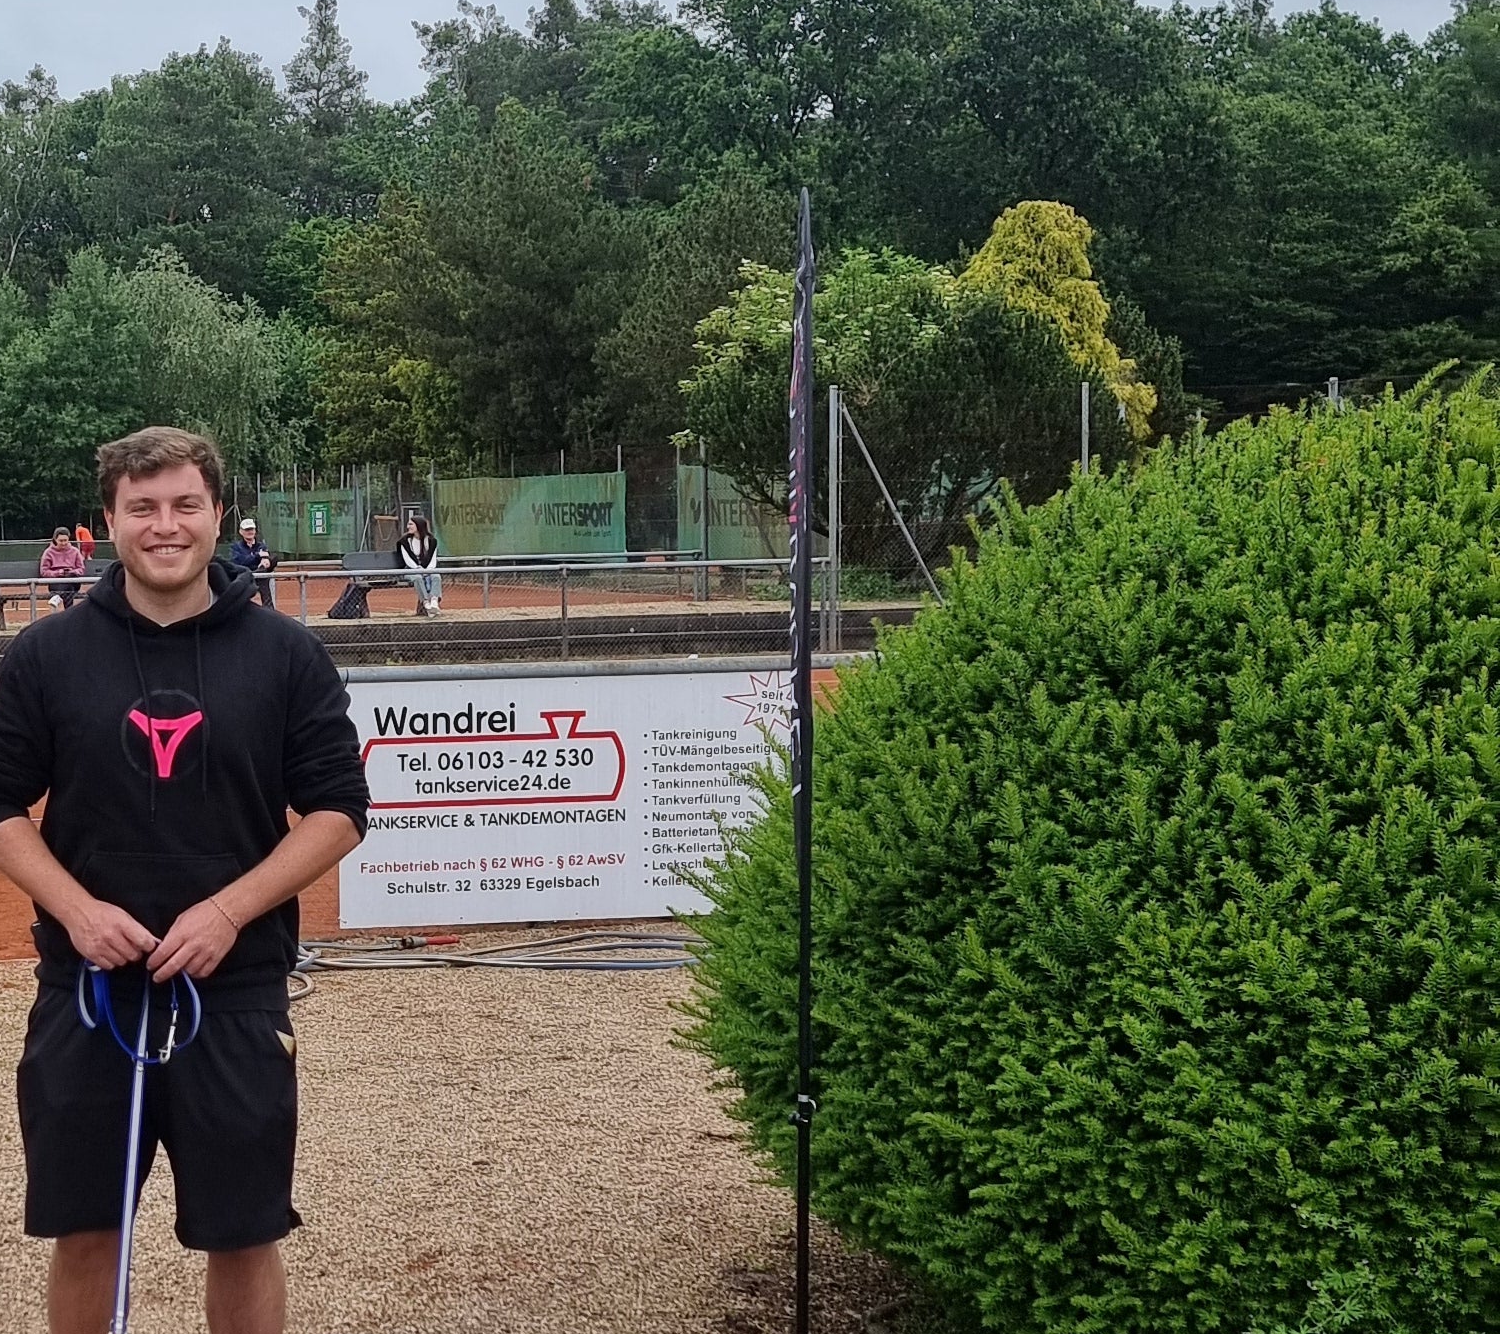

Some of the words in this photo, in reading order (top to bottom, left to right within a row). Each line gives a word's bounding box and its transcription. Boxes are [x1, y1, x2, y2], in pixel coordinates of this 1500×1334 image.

[761, 690, 783, 701] seit
[374, 702, 516, 736] Wandrei
[651, 729, 737, 742] Tankreinigung
[397, 752, 432, 772] Tel.
[437, 750, 504, 771] 06103
[521, 749, 547, 768] 42
[554, 748, 594, 767] 530
[415, 773, 571, 794] tankservice24.de
[651, 793, 741, 806] Tankverfüllung
[367, 814, 458, 830] ANKSERVICE
[463, 814, 475, 827] &
[480, 808, 626, 827] TANKDEMONTAGEN
[360, 860, 439, 873] Fachbetrieb
[443, 859, 476, 871] nach
[479, 858, 488, 872] §
[491, 857, 507, 869] 62
[510, 856, 545, 868] WHG
[556, 856, 564, 869] §
[568, 854, 583, 866] 62
[587, 853, 626, 866] AwSV
[387, 881, 450, 895] Schulstr.
[455, 880, 471, 892] 32
[480, 878, 521, 891] 63329
[526, 875, 600, 892] Egelsbach
